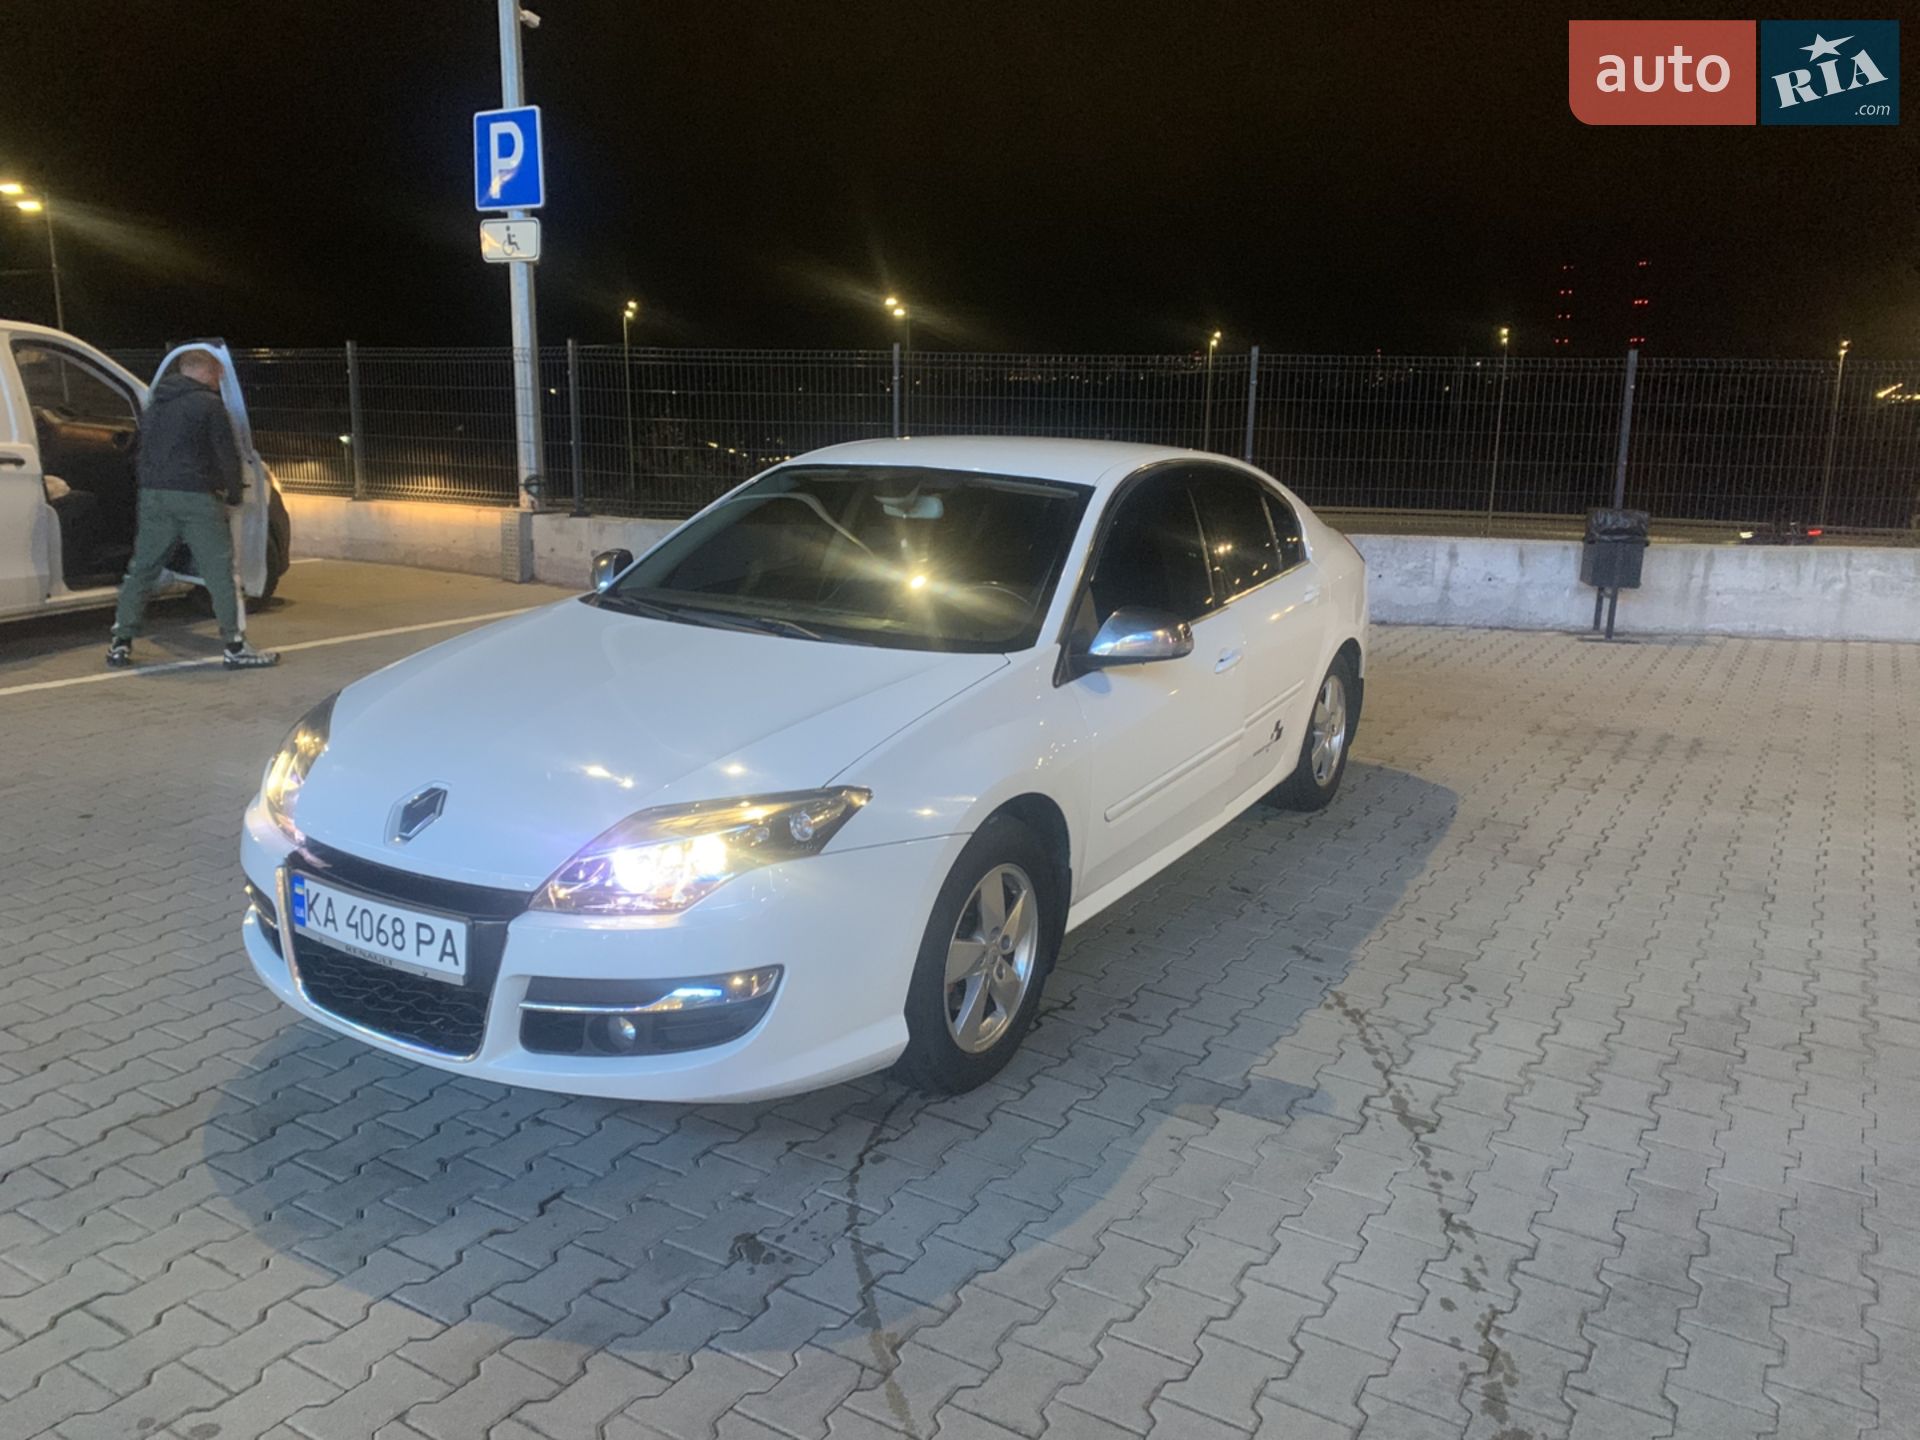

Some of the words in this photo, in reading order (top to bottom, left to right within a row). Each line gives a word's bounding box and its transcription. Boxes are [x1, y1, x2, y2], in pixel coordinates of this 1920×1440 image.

[489, 121, 524, 199] P
[306, 888, 338, 933] KA
[346, 905, 406, 951] 4068
[416, 922, 460, 967] PA
